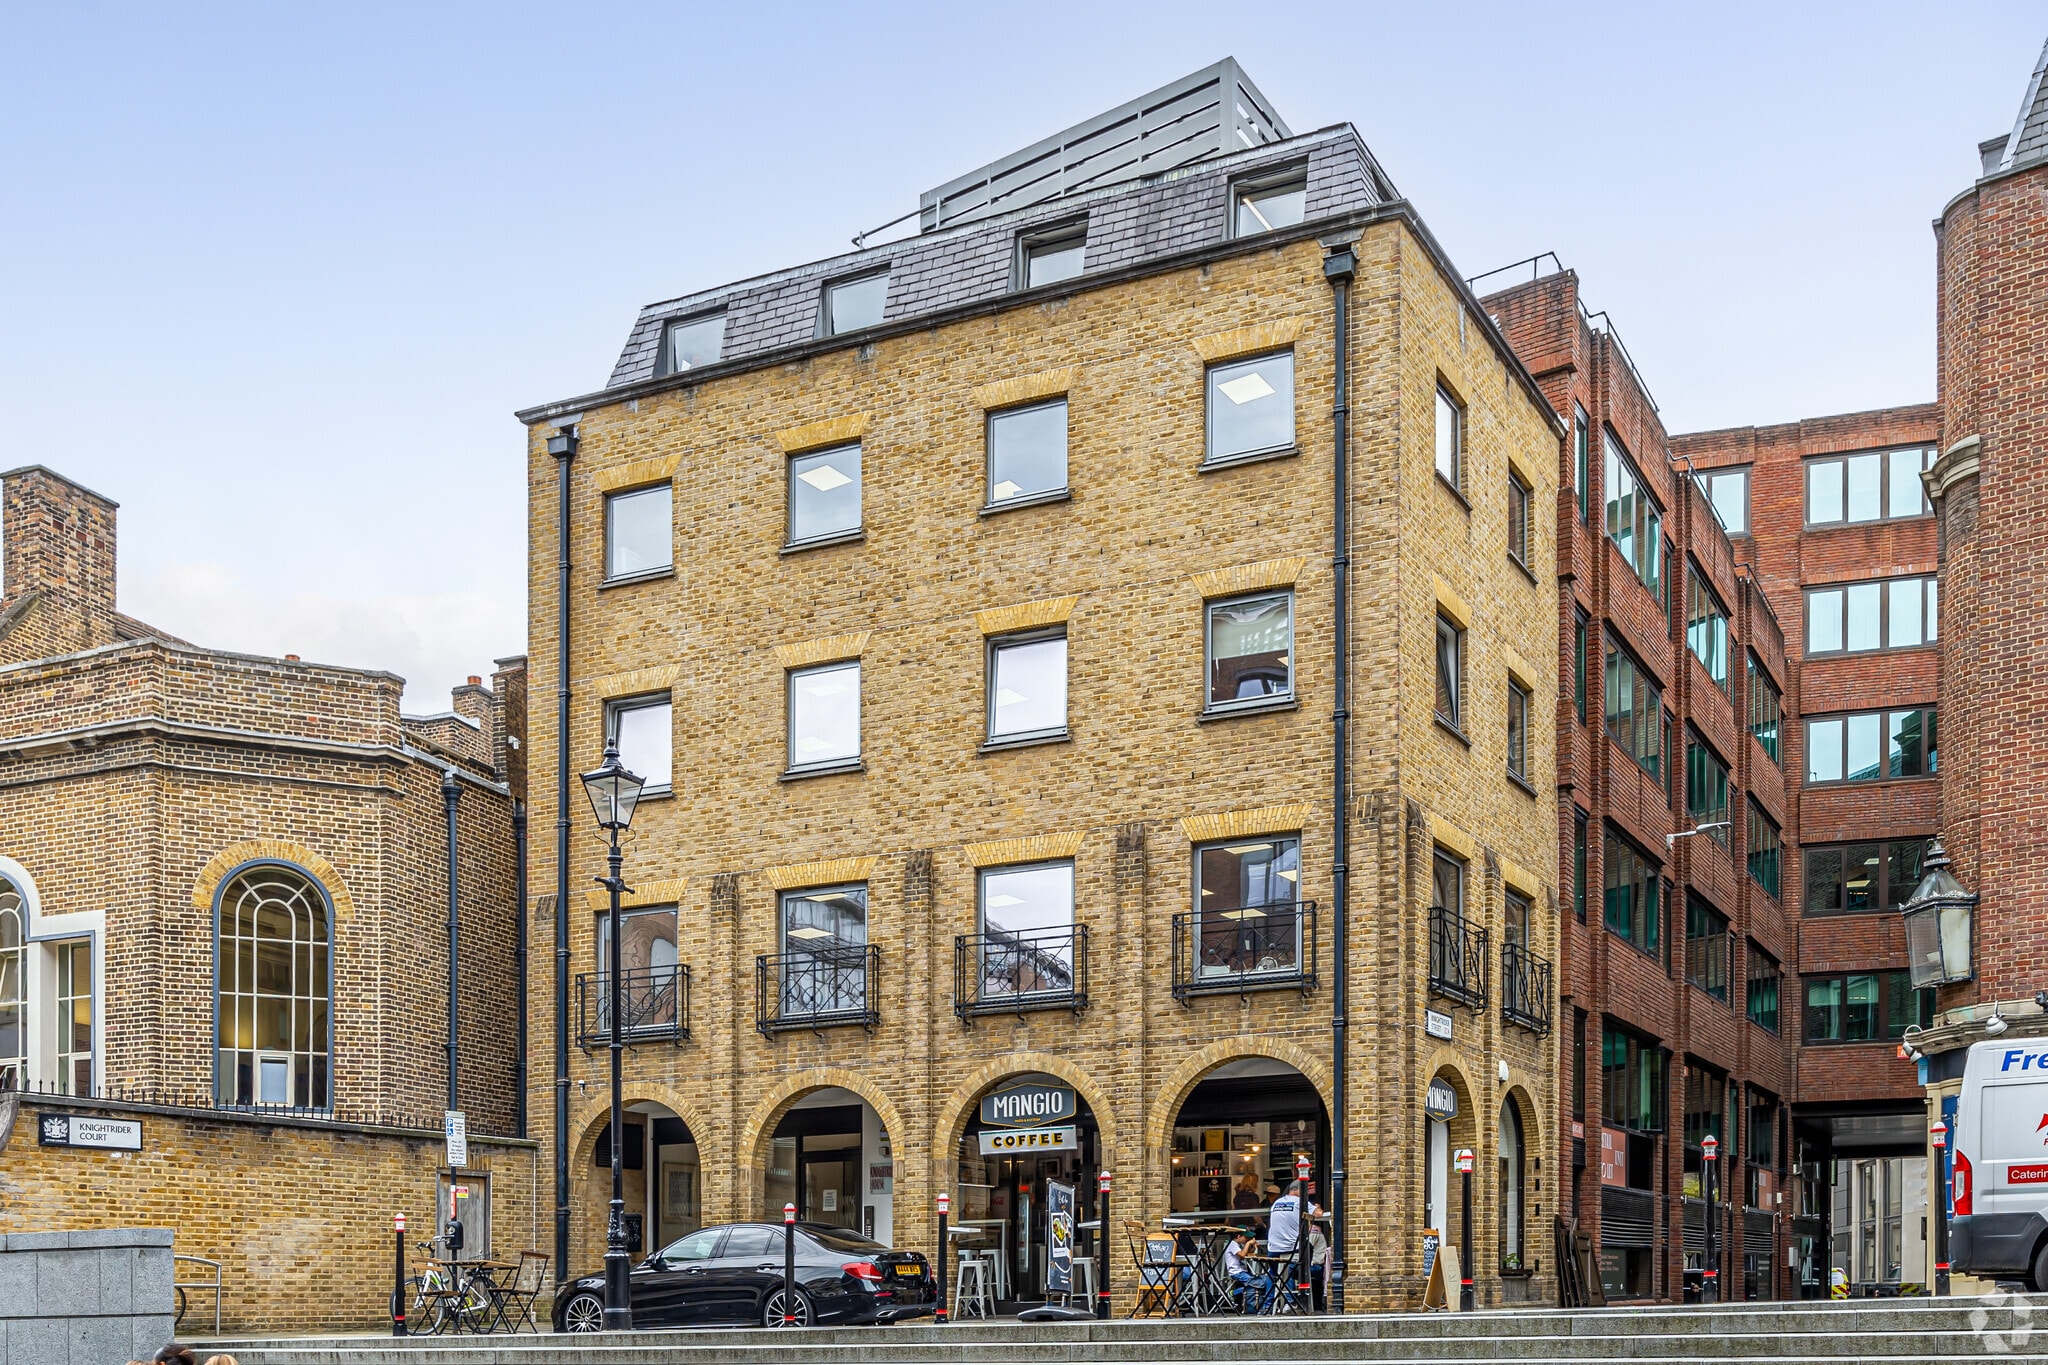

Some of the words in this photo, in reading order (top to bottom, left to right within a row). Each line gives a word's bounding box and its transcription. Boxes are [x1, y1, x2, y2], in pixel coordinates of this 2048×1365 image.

[993, 1091, 1063, 1119] MANGIO
[1426, 1086, 1454, 1112] MANGIO
[79, 1122, 132, 1134] KNIGHTRIDER
[79, 1132, 107, 1142] COURT
[991, 1132, 1063, 1149] COFFEE
